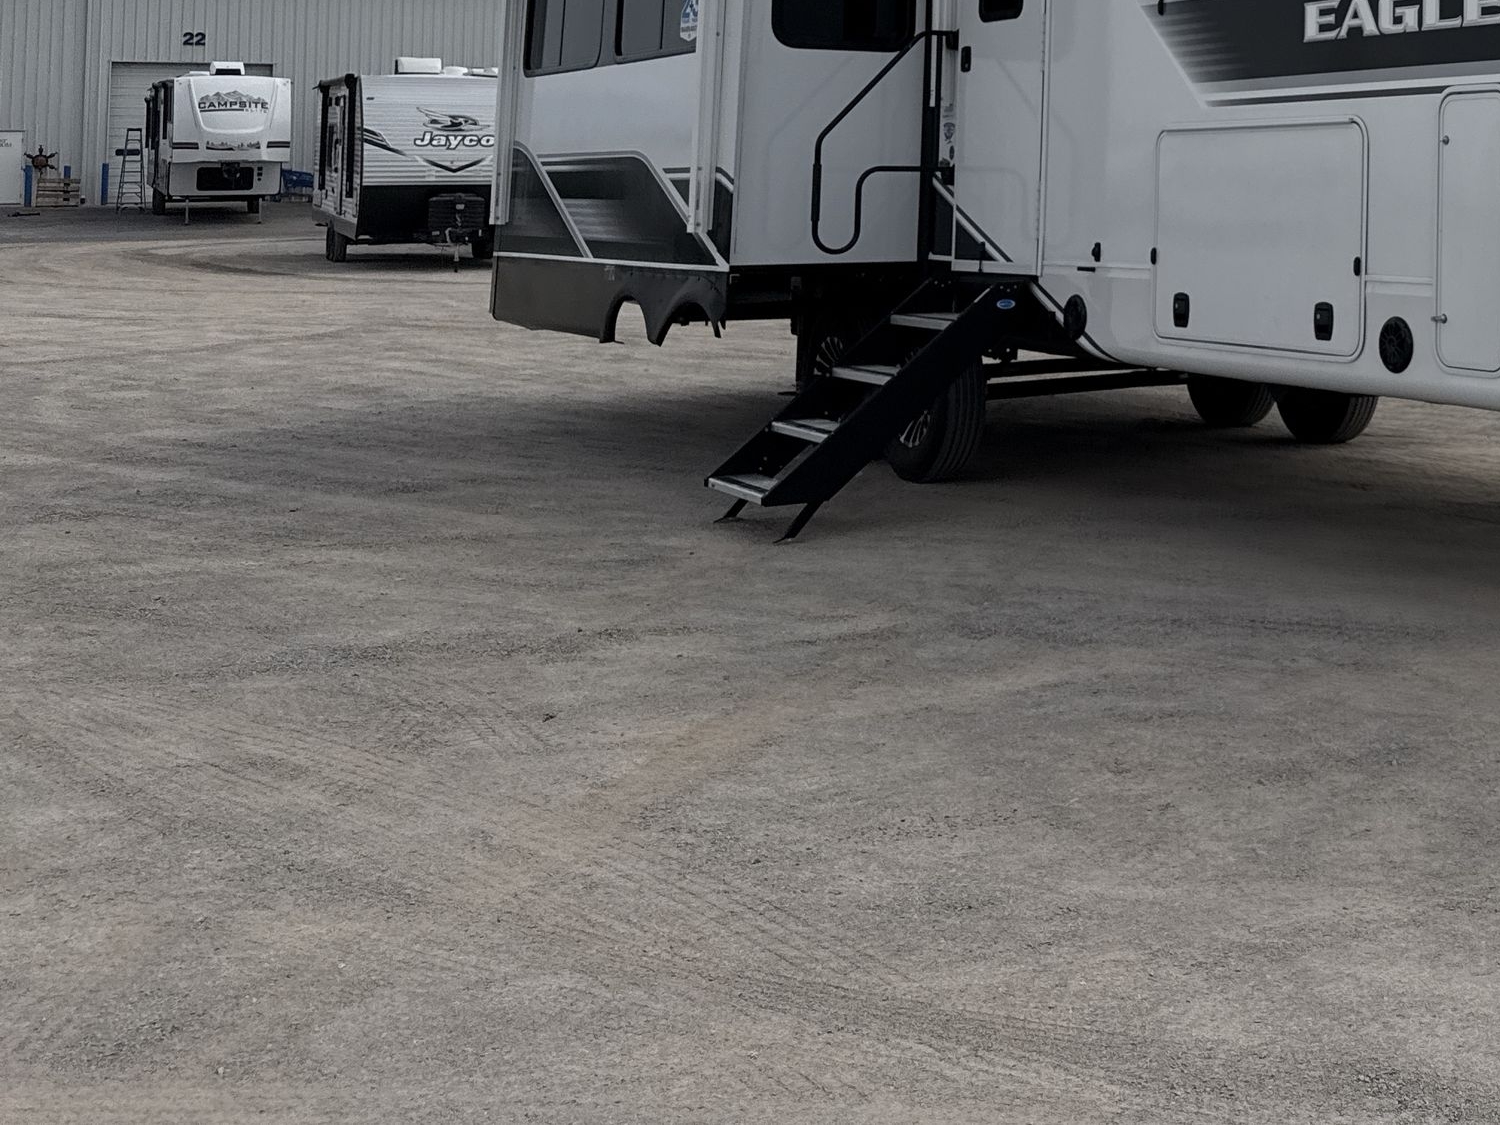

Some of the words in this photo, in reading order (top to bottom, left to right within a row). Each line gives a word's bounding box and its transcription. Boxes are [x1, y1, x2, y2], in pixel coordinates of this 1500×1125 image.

[183, 32, 205, 46] 22
[198, 101, 268, 110] CAMPSITE
[413, 131, 496, 150] Jayco
